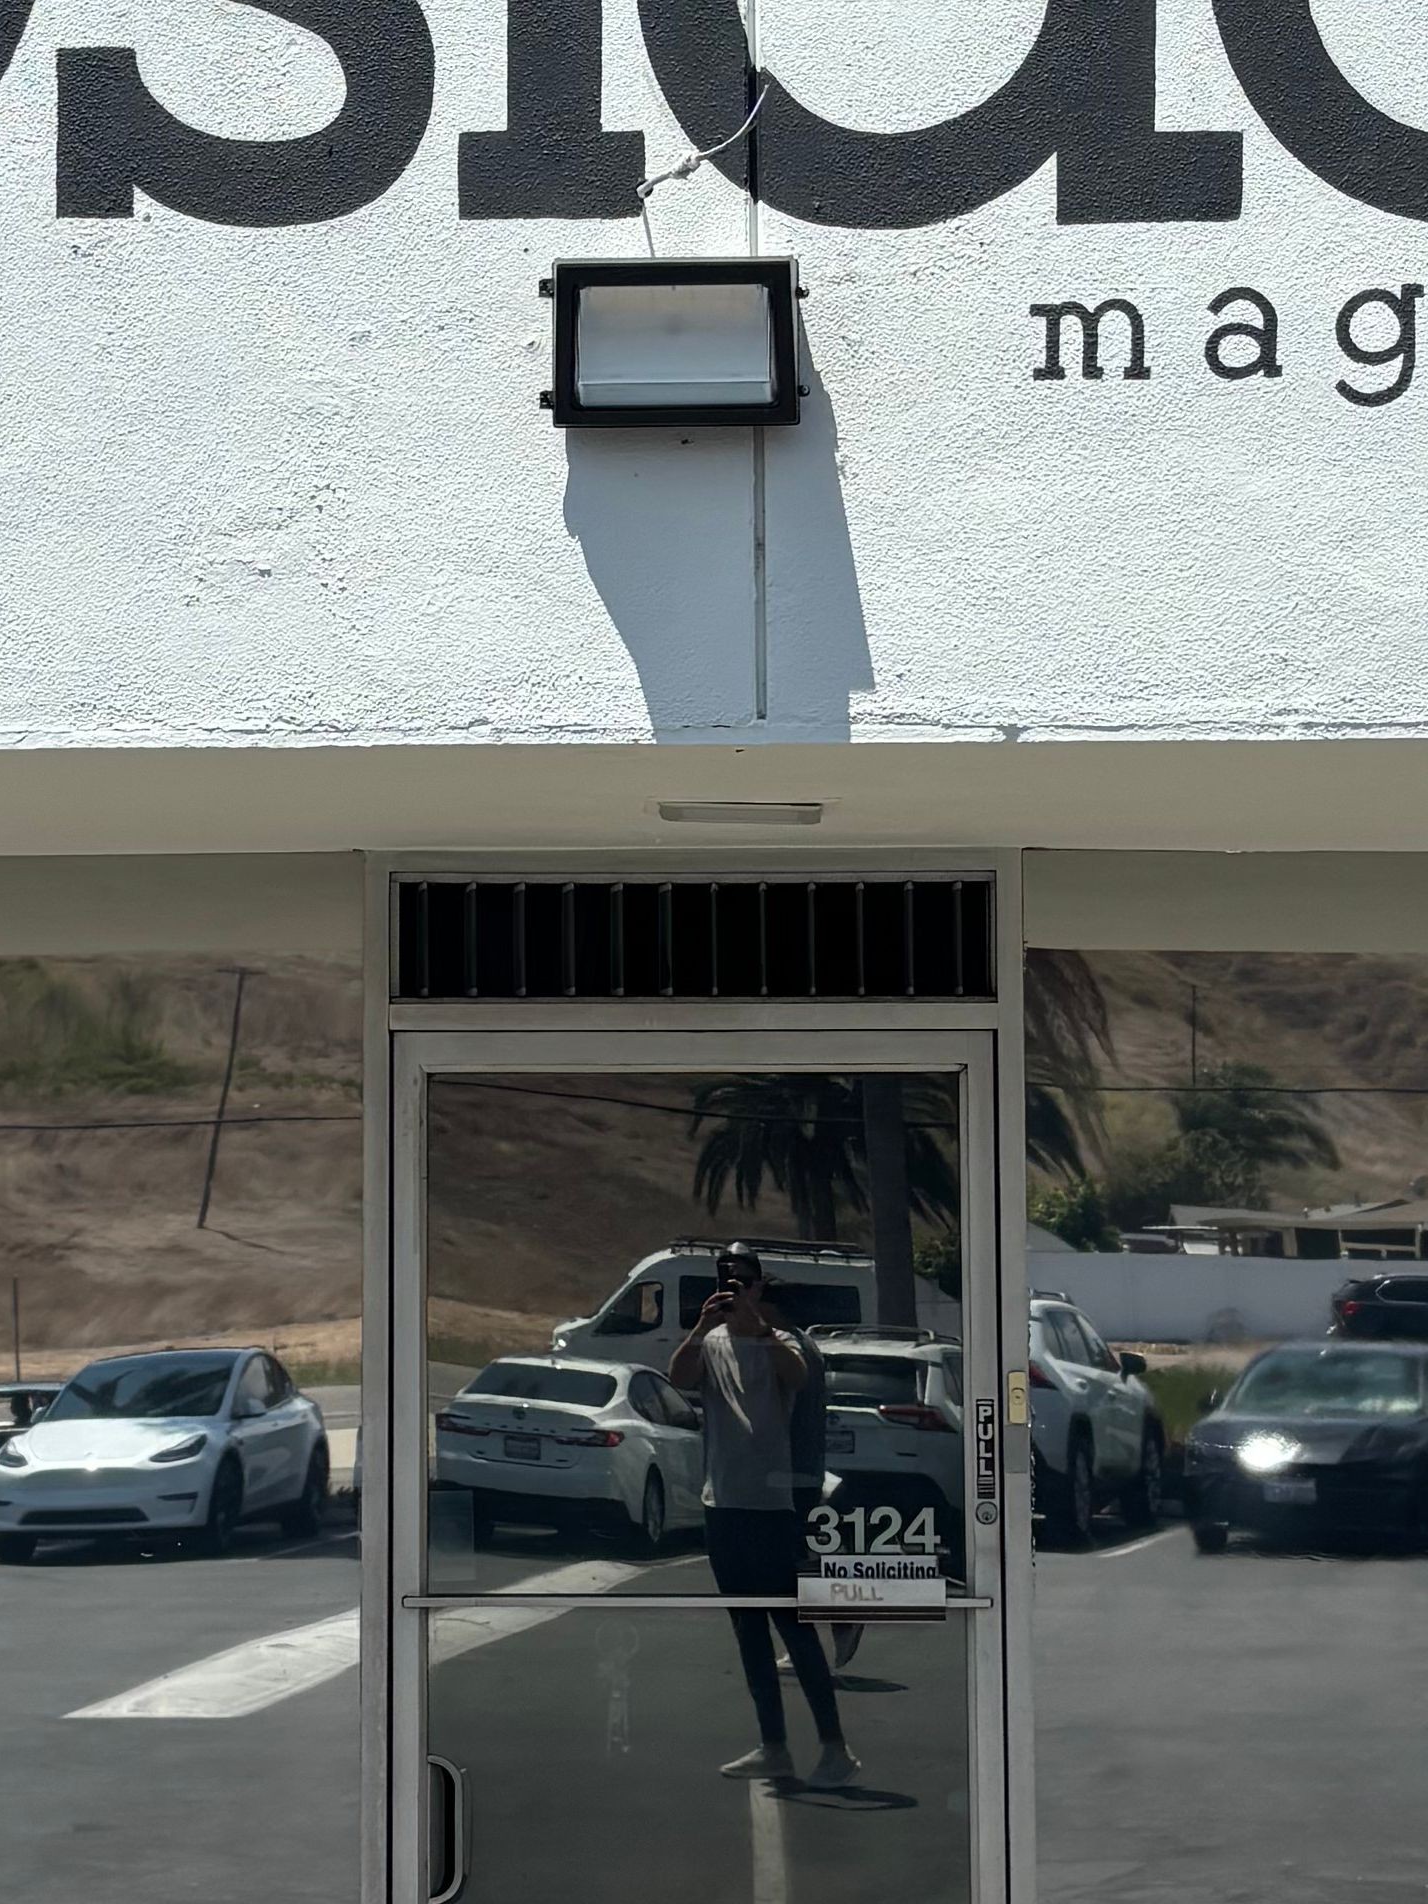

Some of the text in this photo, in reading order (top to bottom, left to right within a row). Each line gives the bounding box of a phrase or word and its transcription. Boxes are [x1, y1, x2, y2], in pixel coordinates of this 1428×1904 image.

[977, 1405, 994, 1476] PULL
[805, 1505, 941, 1554] 3124
[823, 1561, 937, 1579] No Soliciting
[829, 1582, 884, 1602] PULL
